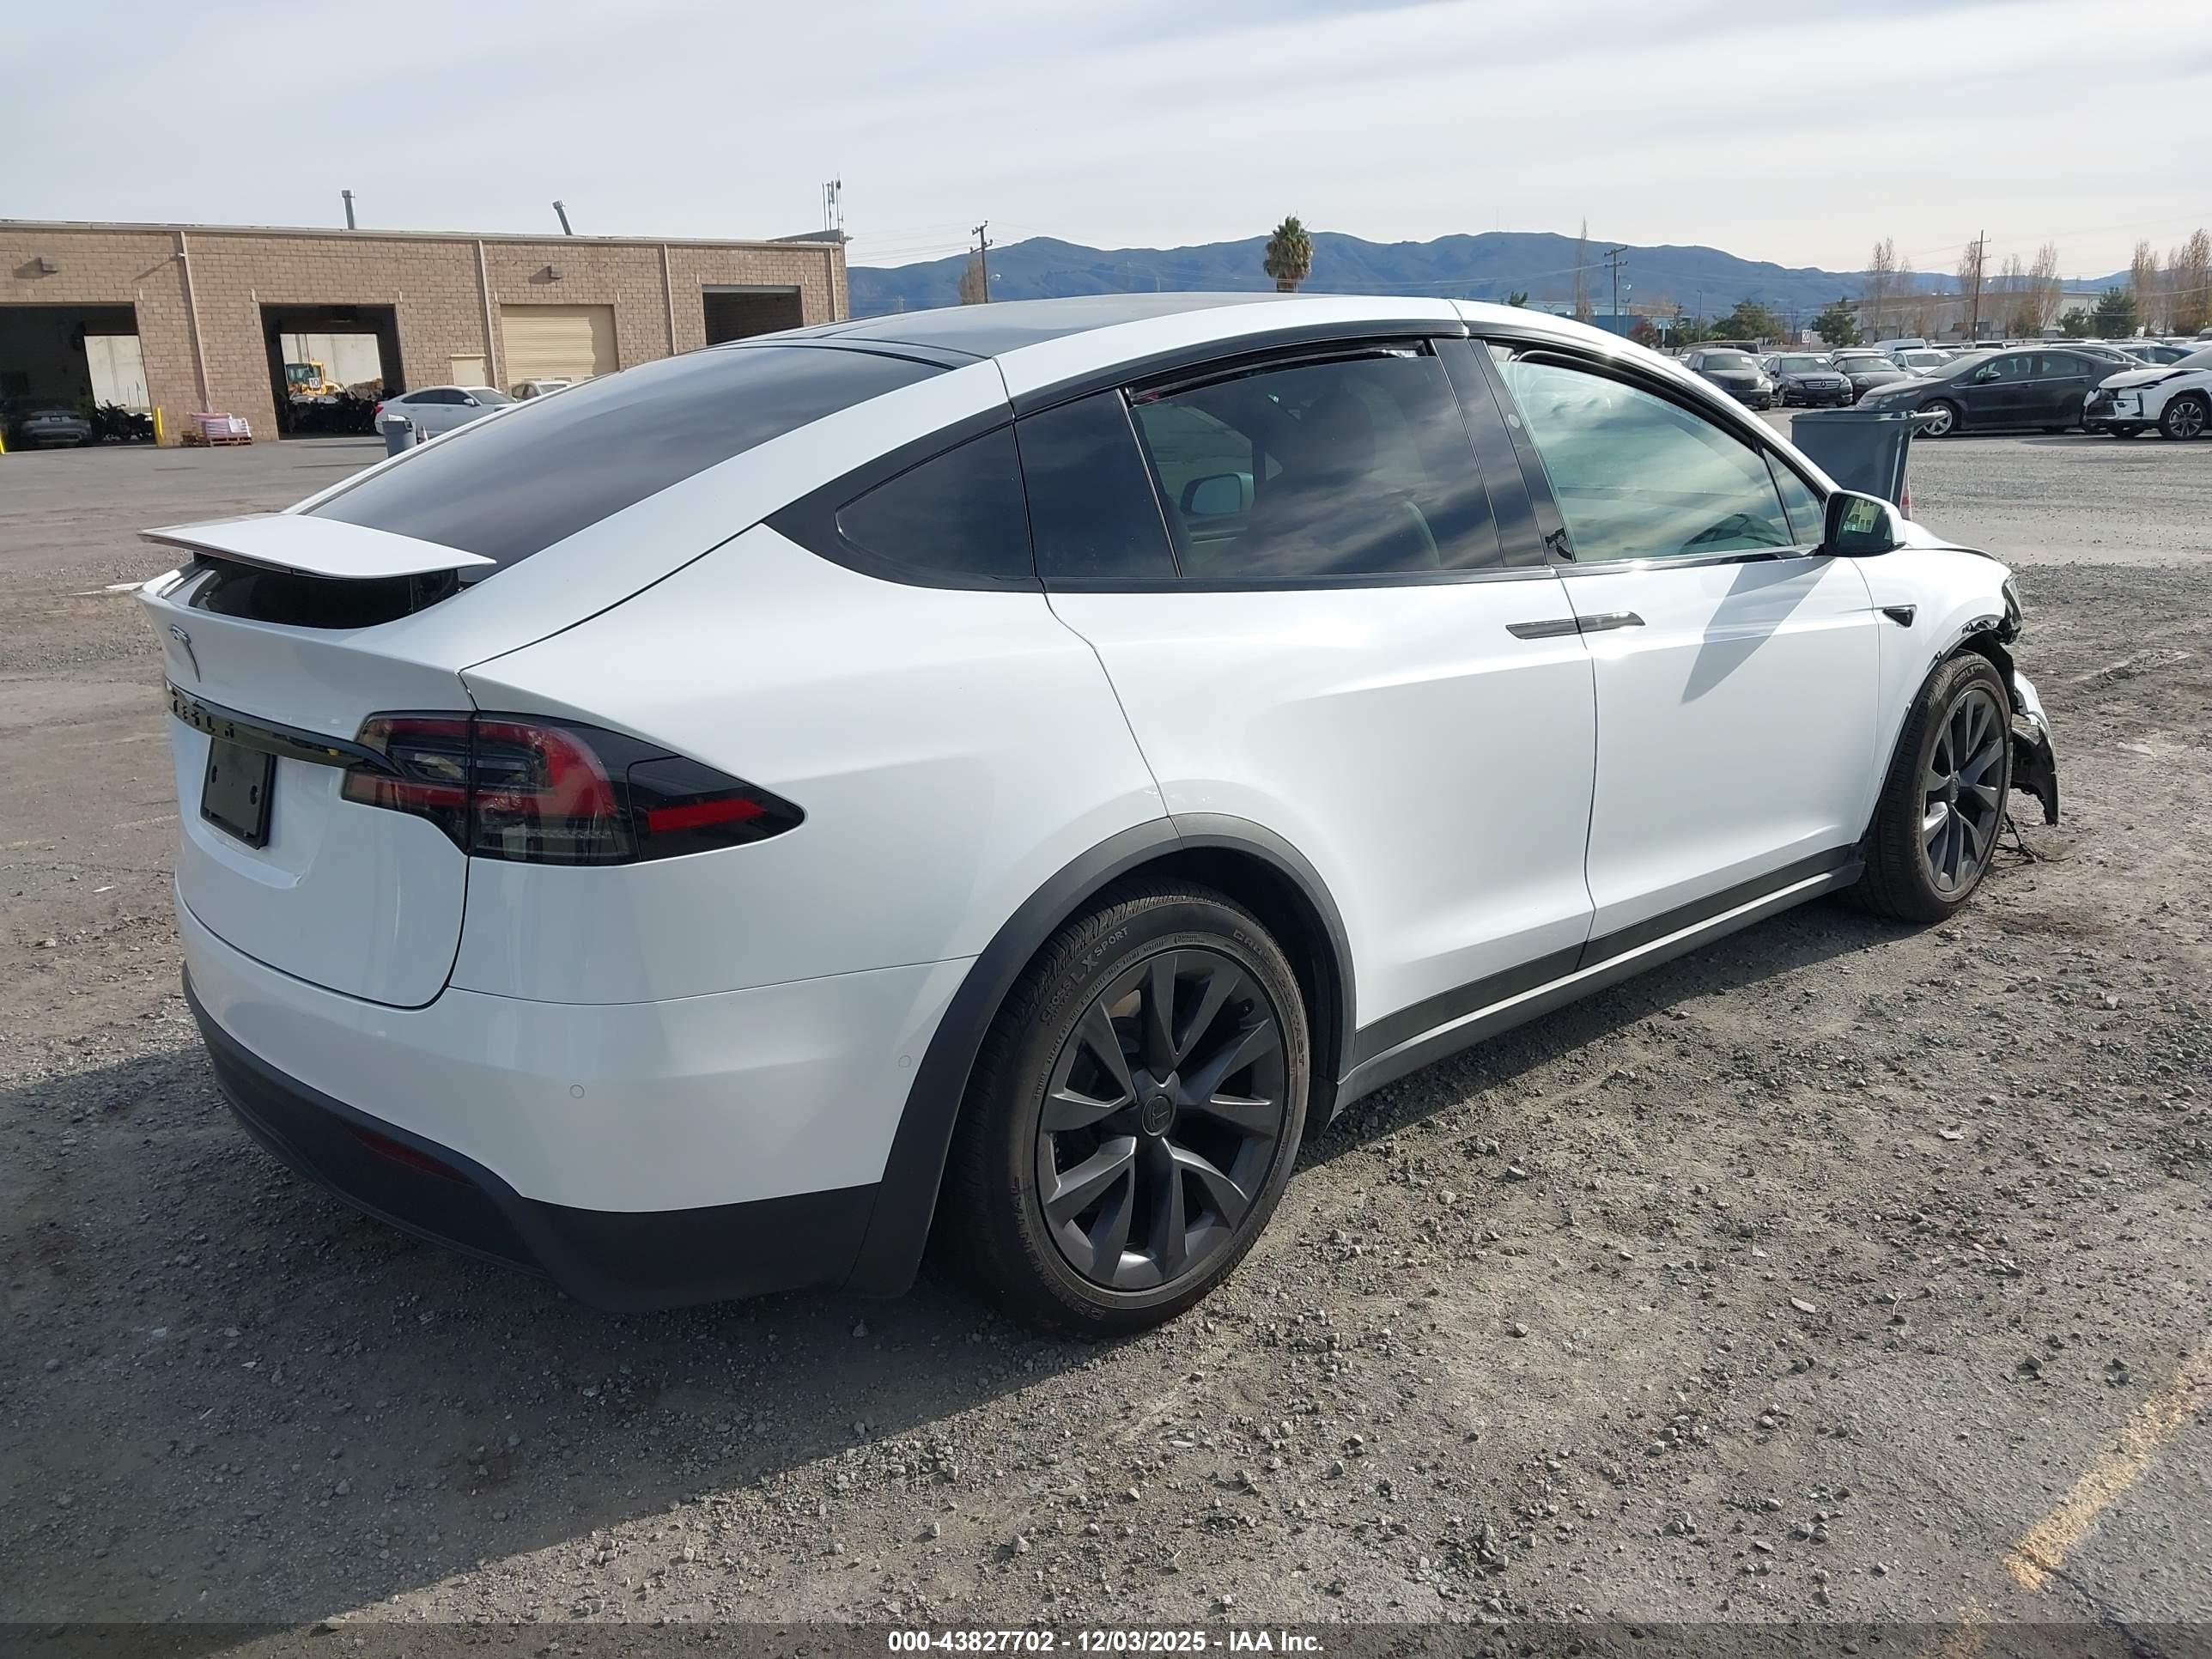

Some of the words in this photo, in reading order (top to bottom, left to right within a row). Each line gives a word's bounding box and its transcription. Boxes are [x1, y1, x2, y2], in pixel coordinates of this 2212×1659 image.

[310, 378, 319, 387] 10
[172, 688, 234, 738] TESLA
[1039, 980, 1073, 1024] CROSS
[1093, 926, 1129, 957] SPORT
